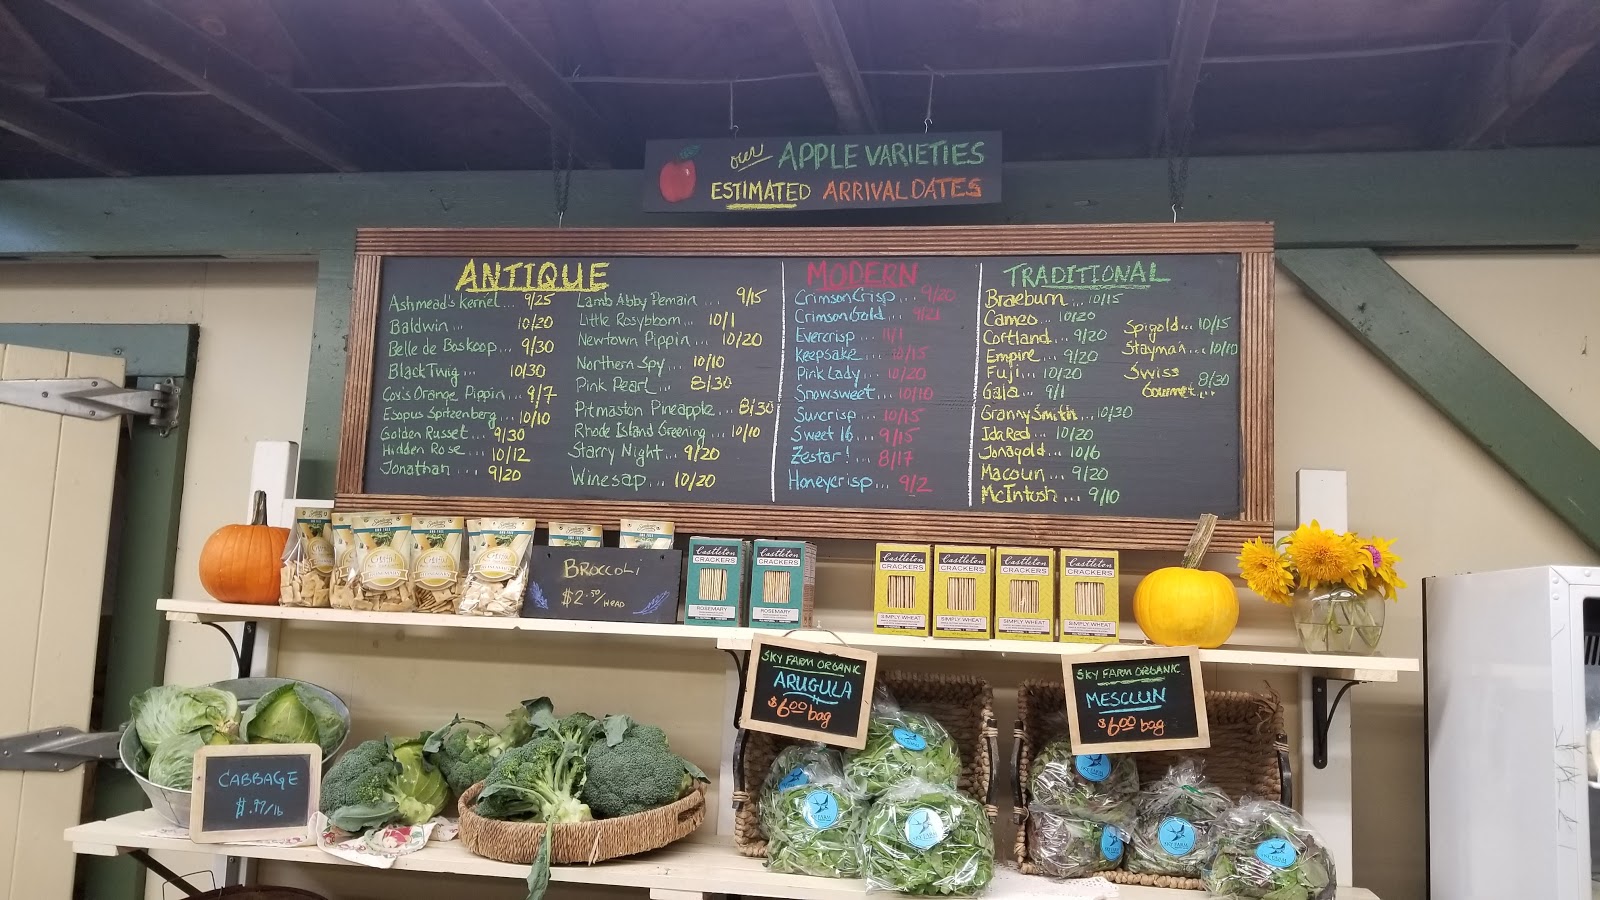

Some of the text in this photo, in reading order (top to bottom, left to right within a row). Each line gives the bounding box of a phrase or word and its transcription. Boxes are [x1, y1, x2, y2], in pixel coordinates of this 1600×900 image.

[778, 141, 858, 171] APPLE
[864, 139, 986, 168] VARIETIES
[711, 180, 811, 202] ESTIMATED
[455, 259, 610, 291] ANTIQUE
[807, 260, 919, 289] MODERN
[1003, 261, 1171, 288] TRADITIONAL
[389, 294, 455, 312] Ashmead's
[524, 292, 555, 310] 9/25
[577, 292, 612, 308] Lamb
[615, 293, 647, 311] Abby
[737, 286, 767, 307] 9/15
[921, 284, 957, 304] 9/20
[1088, 293, 1123, 306] 10/15
[517, 313, 554, 331] 10/20
[579, 312, 611, 327] Little
[709, 311, 735, 330] 10/1
[1059, 311, 1096, 323] 10/20
[1198, 315, 1231, 335] 10/15
[578, 332, 638, 346] Newtown
[722, 332, 763, 348] 10/20
[882, 327, 903, 342] 11/1
[1073, 328, 1108, 344] 9/20
[388, 340, 418, 357] Belle
[422, 338, 437, 355] de
[521, 335, 555, 355] 9/30
[1209, 341, 1238, 357] 10/10
[576, 355, 634, 371] Northern
[693, 354, 725, 371] 10/10
[1063, 349, 1098, 364] 9/20
[510, 363, 546, 380] 10/30
[1043, 367, 1082, 381] 10/20
[1123, 361, 1180, 380] Swiss
[1198, 371, 1230, 388] 8/30
[575, 376, 607, 393] Pink
[690, 375, 732, 392] 8/30
[1045, 383, 1066, 400] 9/1
[414, 386, 459, 406] Orange
[527, 383, 557, 409] 9/7
[898, 386, 934, 403] 10/10
[575, 400, 644, 418] Pitmaston
[883, 408, 927, 424] 10/15
[1097, 405, 1133, 422] 10/30
[519, 410, 551, 428] 10/10
[380, 425, 421, 441] Golden
[494, 427, 525, 443] 9/30
[574, 422, 611, 438] Rhode
[615, 420, 653, 438] Island
[731, 423, 761, 443] 10/10
[790, 426, 834, 442] Sweet
[879, 427, 920, 447] 9/15
[1056, 425, 1094, 441] 10/20
[383, 444, 424, 457] Hidden
[492, 446, 531, 464] 10/12
[567, 441, 615, 465] Starry
[684, 444, 720, 462] 9/20
[878, 449, 914, 470] 8/17
[1070, 445, 1101, 461] 10/6
[488, 465, 521, 482] 9/20
[674, 471, 716, 491] 10/20
[1071, 465, 1109, 482] 9/20
[899, 474, 933, 493] 9/2
[1088, 486, 1120, 506] 9/10
[696, 545, 736, 556] Castleton
[760, 547, 799, 558] Castleton
[883, 552, 924, 563] Castleton
[942, 554, 984, 565] Castleton
[694, 556, 736, 564] CRACKERS
[758, 558, 799, 566] CRACKERS
[881, 563, 924, 571] CRACKERS
[940, 565, 985, 573] CRACKERS
[1003, 556, 1047, 567] Castleton
[1068, 557, 1112, 568] Castleton
[1067, 569, 1113, 577] CRACKERS
[761, 650, 862, 675] SKY FARM ORGANIC
[1076, 663, 1181, 680] SKY FARM ORGANIC
[773, 671, 852, 700] ARUGULA
[1085, 687, 1167, 709] MESCLUN
[808, 704, 832, 729] bag
[1140, 718, 1165, 737] bag
[218, 769, 299, 790] CABBAGE
